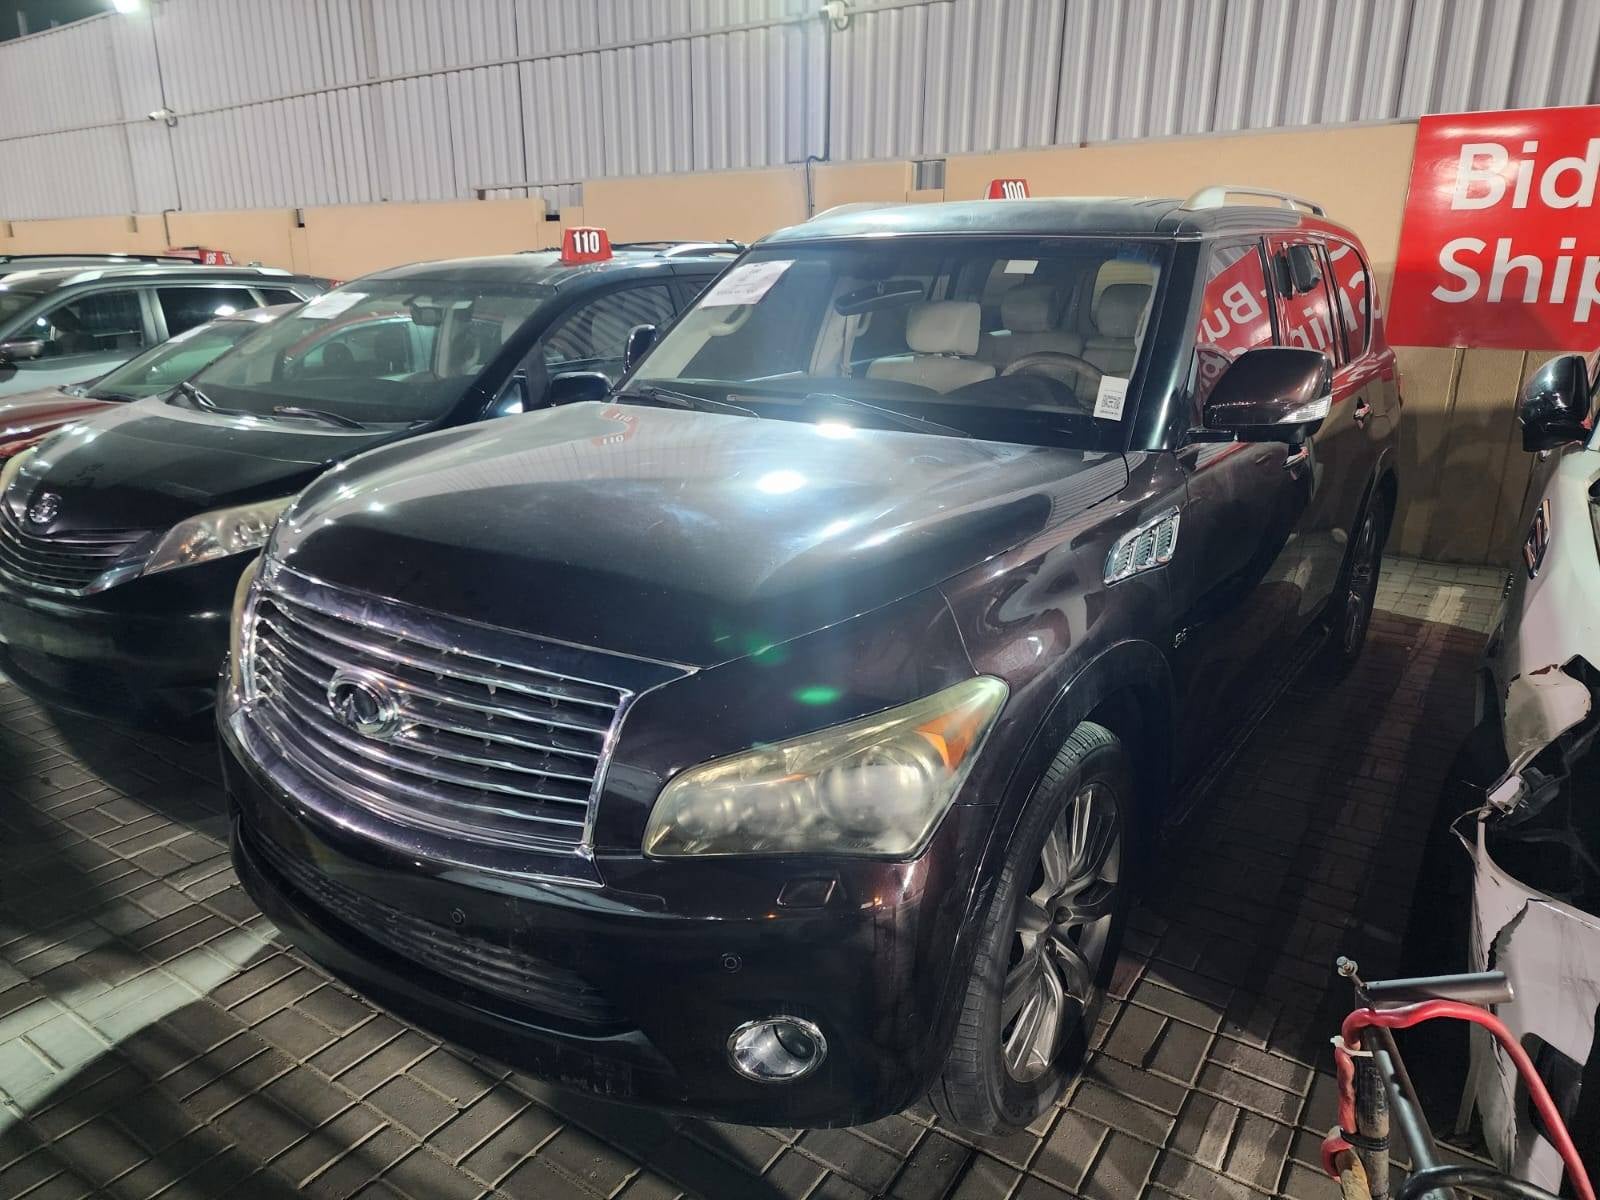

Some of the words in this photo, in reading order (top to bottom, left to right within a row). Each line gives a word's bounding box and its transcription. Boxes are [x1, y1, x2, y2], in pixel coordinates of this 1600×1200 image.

[1451, 137, 1600, 210] Bid
[1002, 181, 1026, 200] 100
[573, 231, 600, 254] 110
